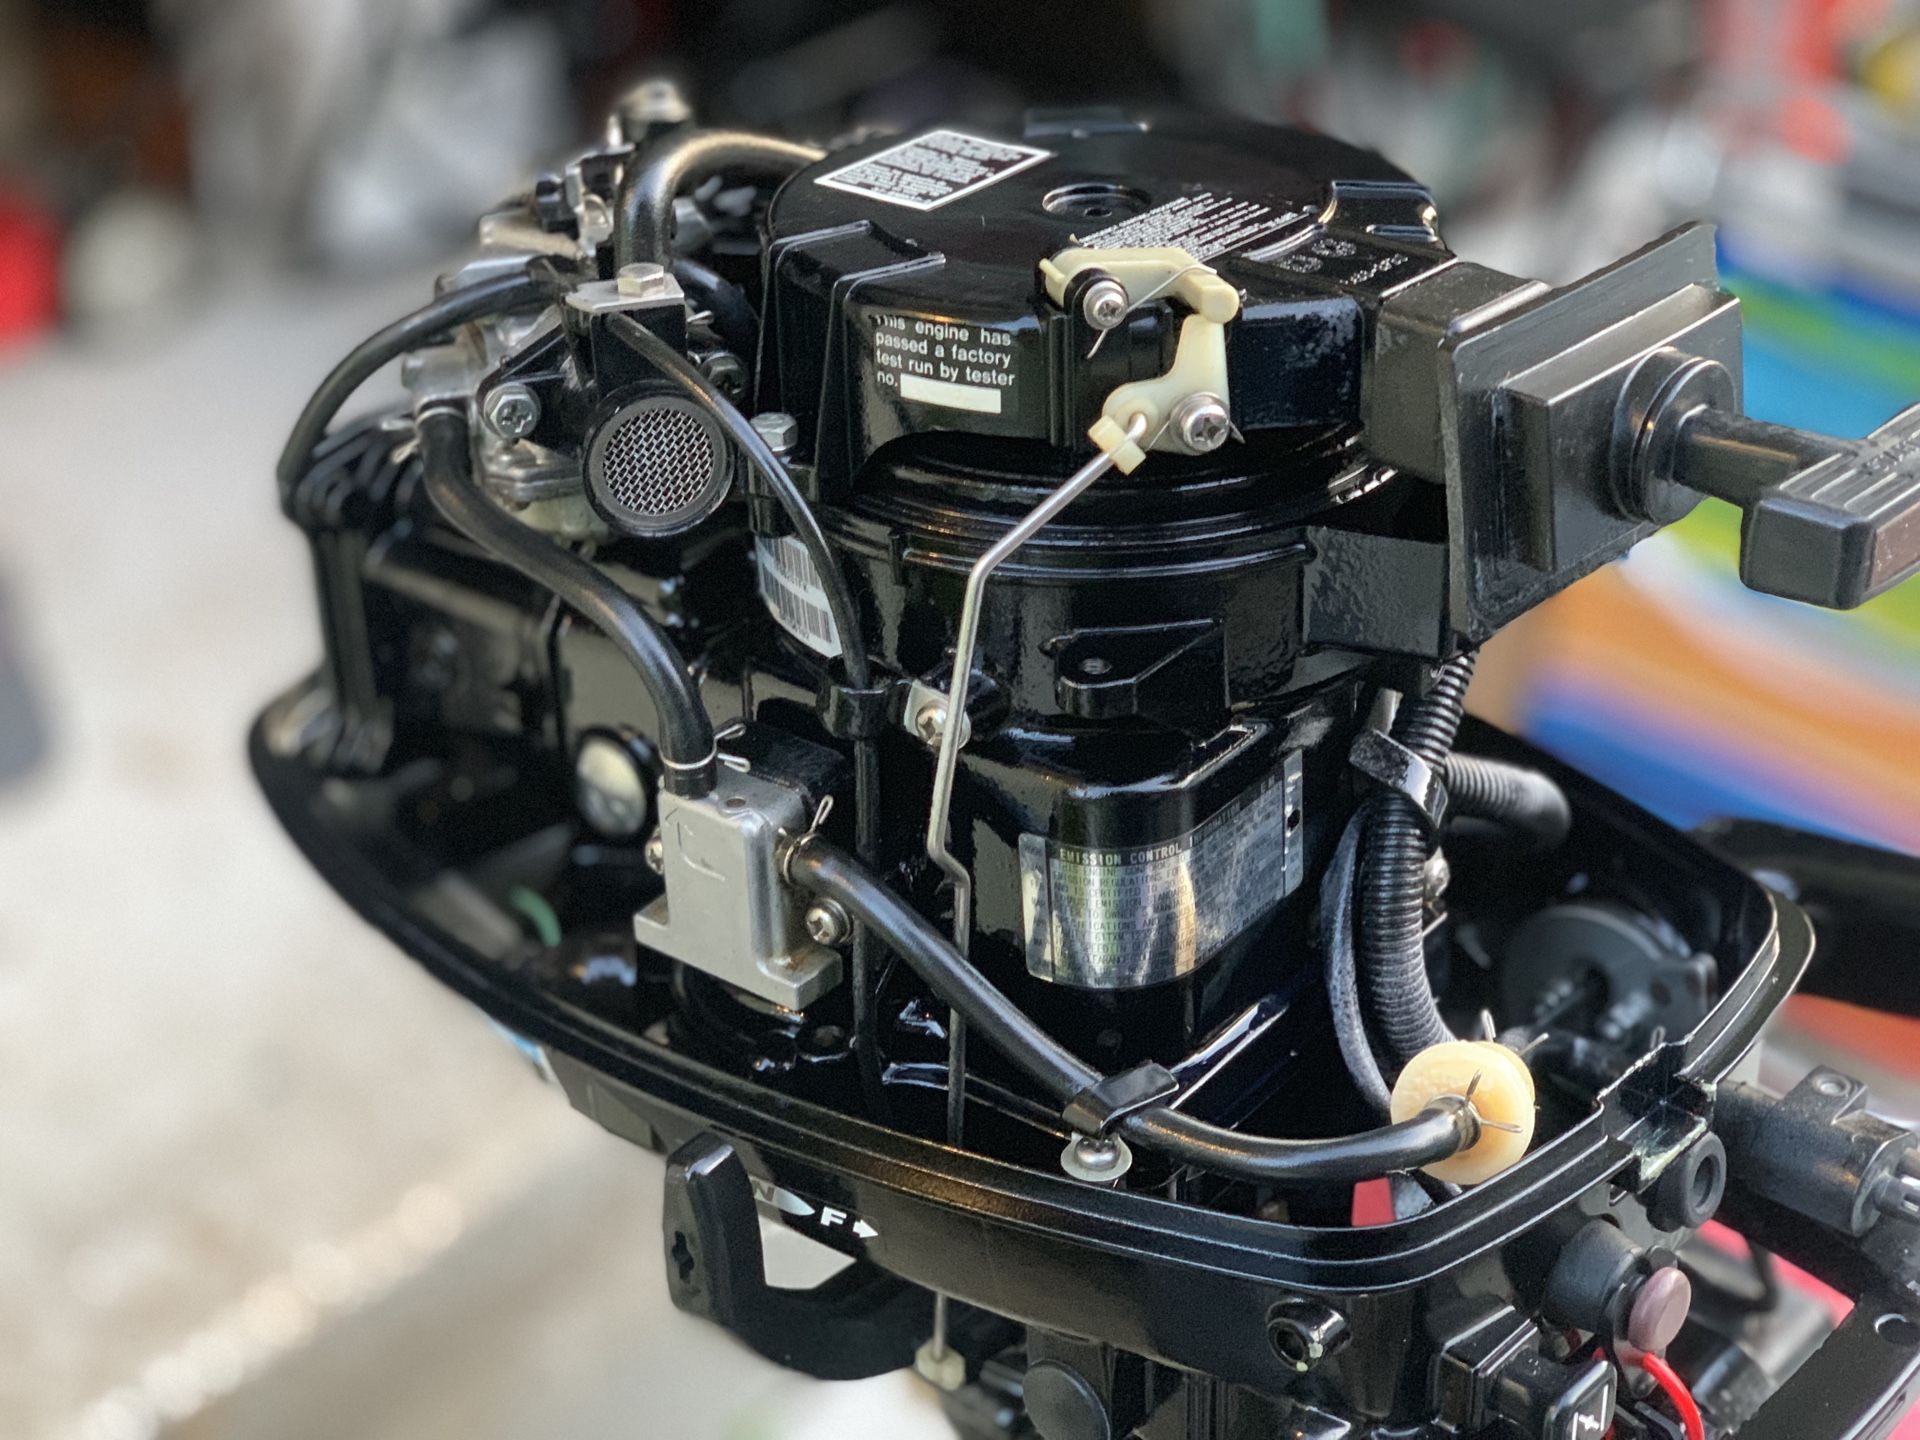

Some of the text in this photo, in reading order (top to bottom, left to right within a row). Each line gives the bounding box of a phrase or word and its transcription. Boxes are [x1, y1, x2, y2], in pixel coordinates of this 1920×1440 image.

[915, 320, 970, 341] engine
[980, 328, 1012, 346] has
[875, 331, 1011, 369] passed a factory
[876, 349, 1016, 386] test run by tester
[876, 370, 899, 387] no.
[1059, 842, 1183, 866] EMISSION CONTROL
[820, 1206, 847, 1227] F
